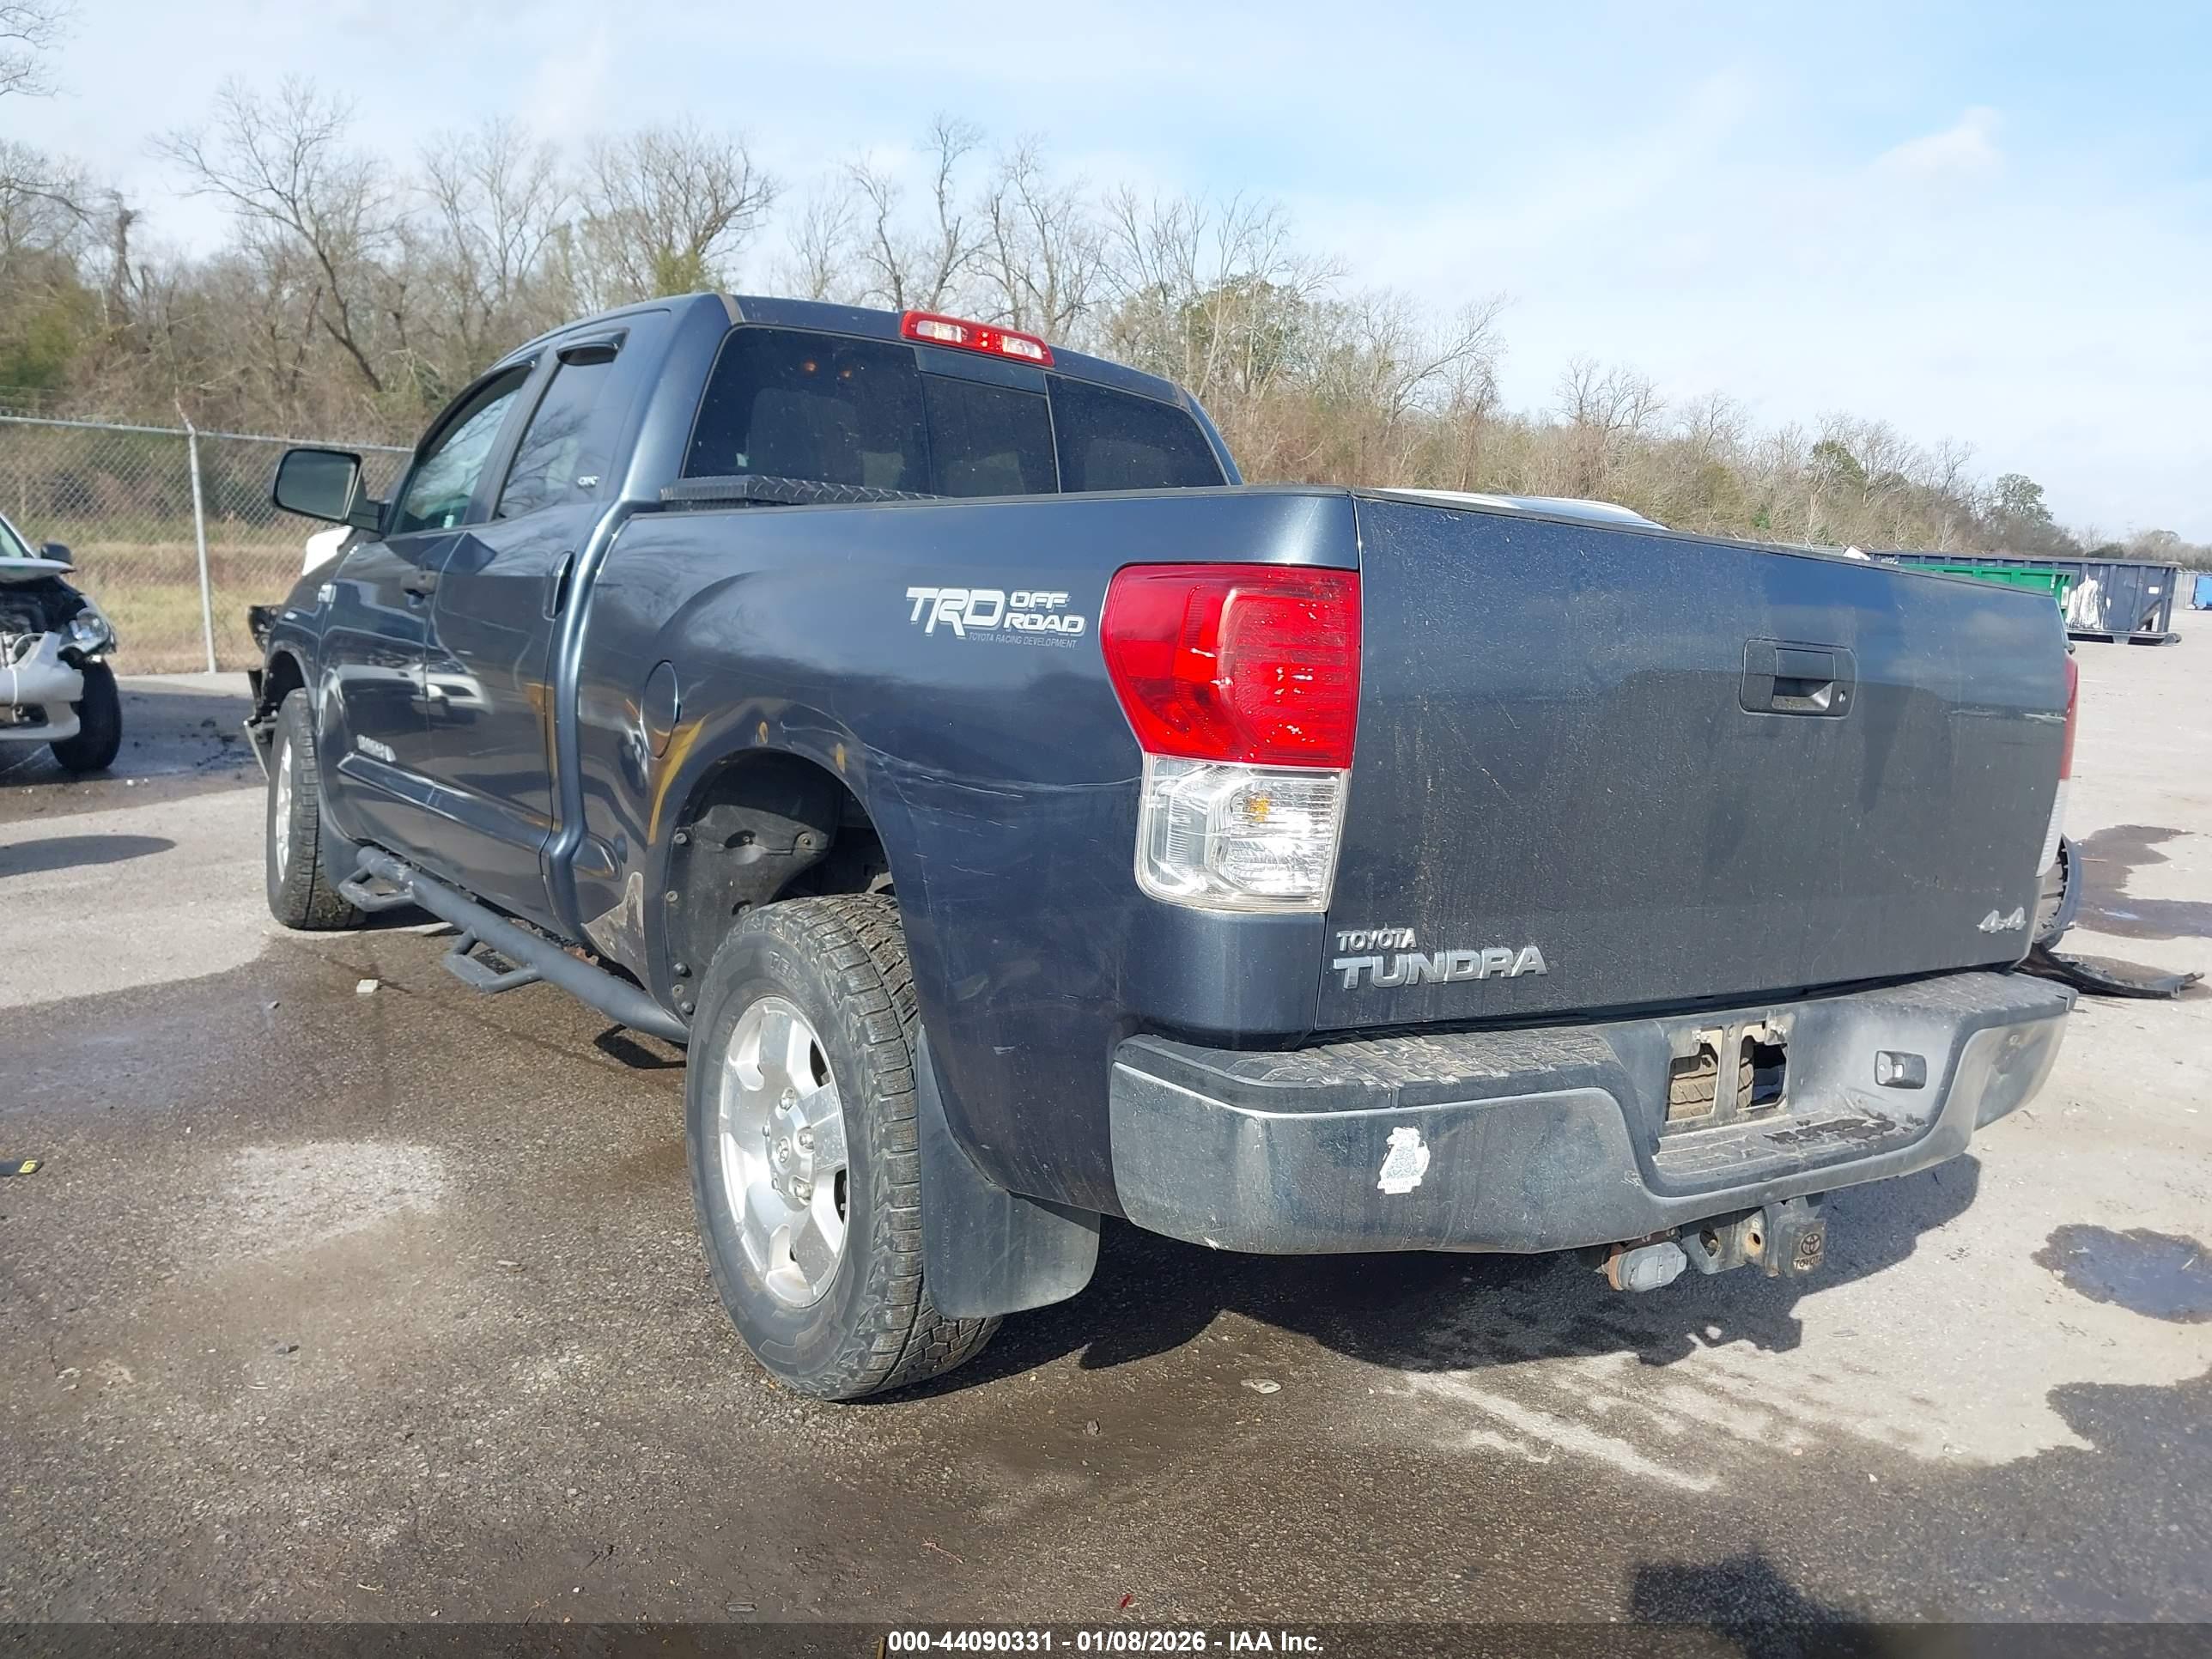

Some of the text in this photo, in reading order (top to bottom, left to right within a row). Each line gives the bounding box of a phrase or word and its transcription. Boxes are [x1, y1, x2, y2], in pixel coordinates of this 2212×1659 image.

[906, 586, 1006, 638] TRD
[1008, 590, 1072, 611] OFF
[1003, 611, 1087, 637] ROAD
[969, 630, 1078, 649] TOYOTA RACING DEVELOPMENT
[1336, 927, 1418, 952] TOYOTA
[1333, 945, 1548, 990] TUNDRA
